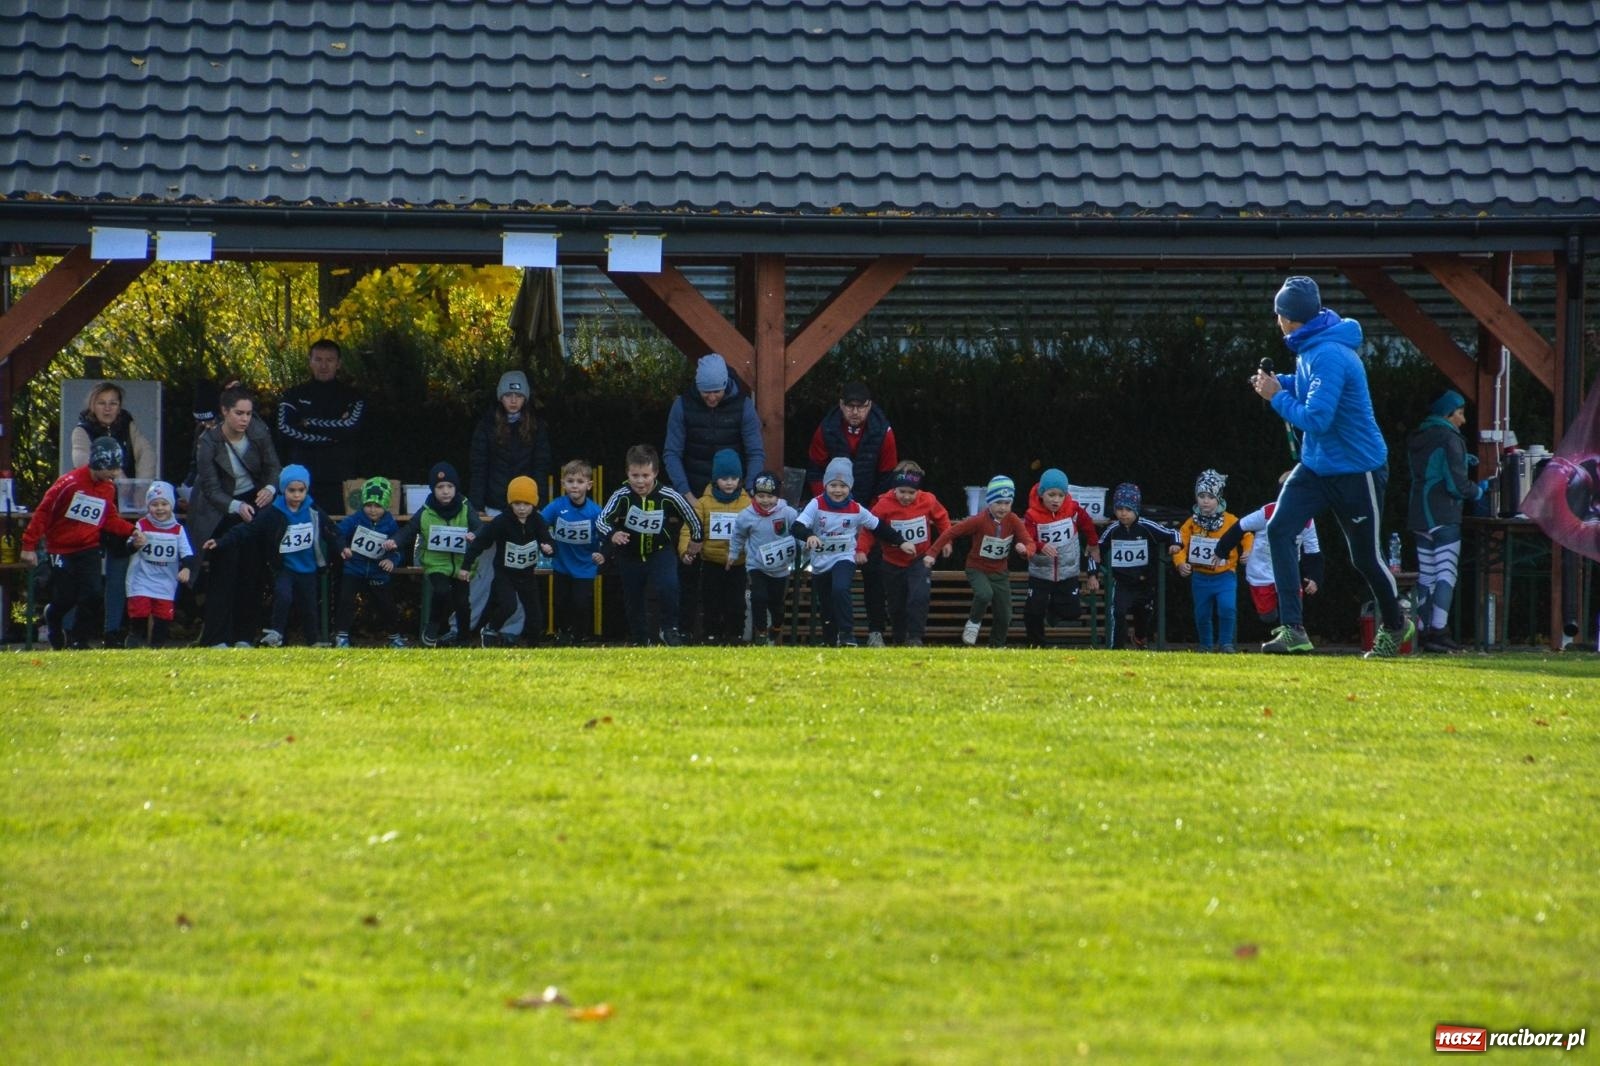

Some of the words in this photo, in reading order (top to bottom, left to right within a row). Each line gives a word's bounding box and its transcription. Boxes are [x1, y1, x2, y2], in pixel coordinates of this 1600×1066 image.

[70, 503, 101, 520] 469
[628, 515, 661, 530] 545
[711, 521, 733, 535] 41
[281, 532, 312, 548] 434
[556, 528, 589, 540] 425
[898, 526, 926, 541] 06
[1041, 528, 1071, 544] 521
[354, 536, 384, 554] 407
[430, 535, 464, 549] 412
[815, 543, 847, 553] 541
[142, 543, 176, 558] 409
[506, 550, 537, 565] 555
[765, 545, 796, 566] 515
[1113, 549, 1146, 562] 404
[1190, 546, 1213, 560] 43
